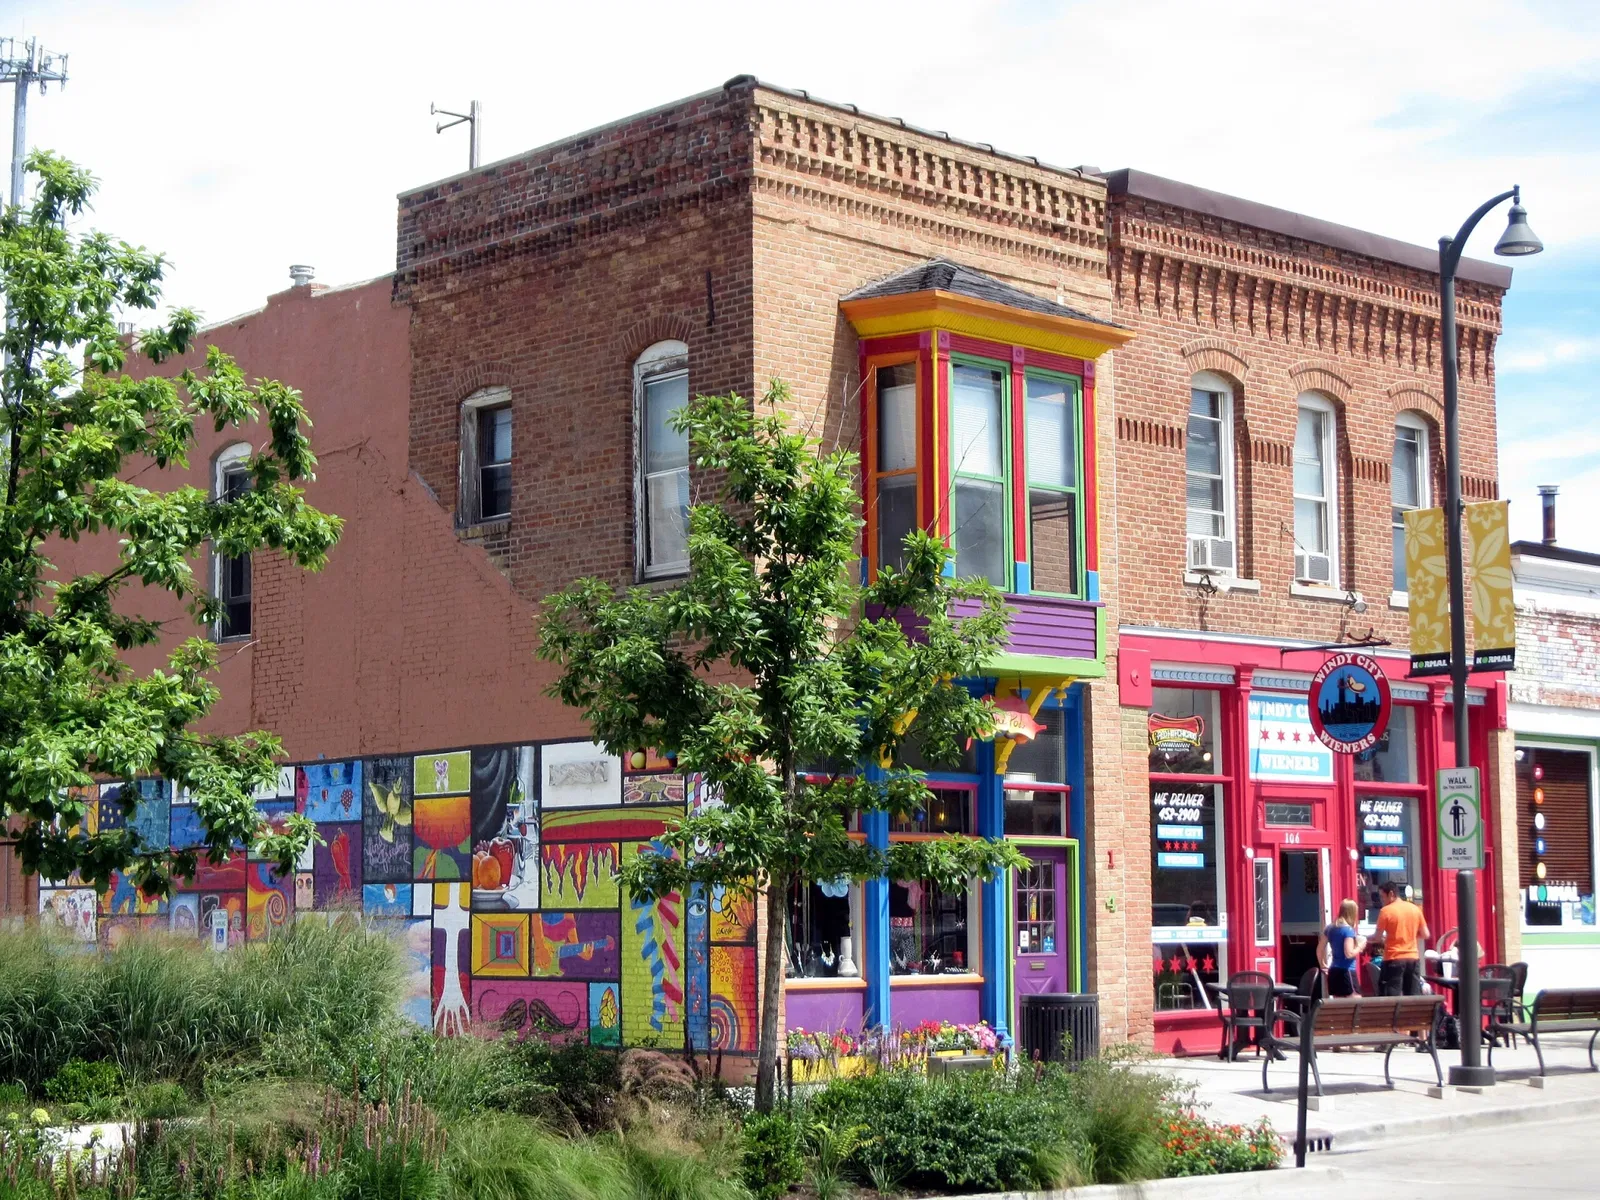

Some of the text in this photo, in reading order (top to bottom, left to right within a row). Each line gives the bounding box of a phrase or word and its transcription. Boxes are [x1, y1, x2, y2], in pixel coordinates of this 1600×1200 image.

[1314, 653, 1384, 683] WINDY CITY
[1248, 700, 1294, 719] WINDY
[1320, 729, 1376, 754] WIENERS
[1259, 753, 1320, 773] WIENERS
[1447, 776, 1467, 785] WALK
[1154, 792, 1204, 807] WE DELIVER
[1360, 800, 1403, 813] WE DELIVER
[1158, 807, 1200, 821] 452-2900
[1363, 813, 1400, 827] 452-2900
[1285, 832, 1300, 844] 106
[1451, 847, 1467, 856] RIDE
